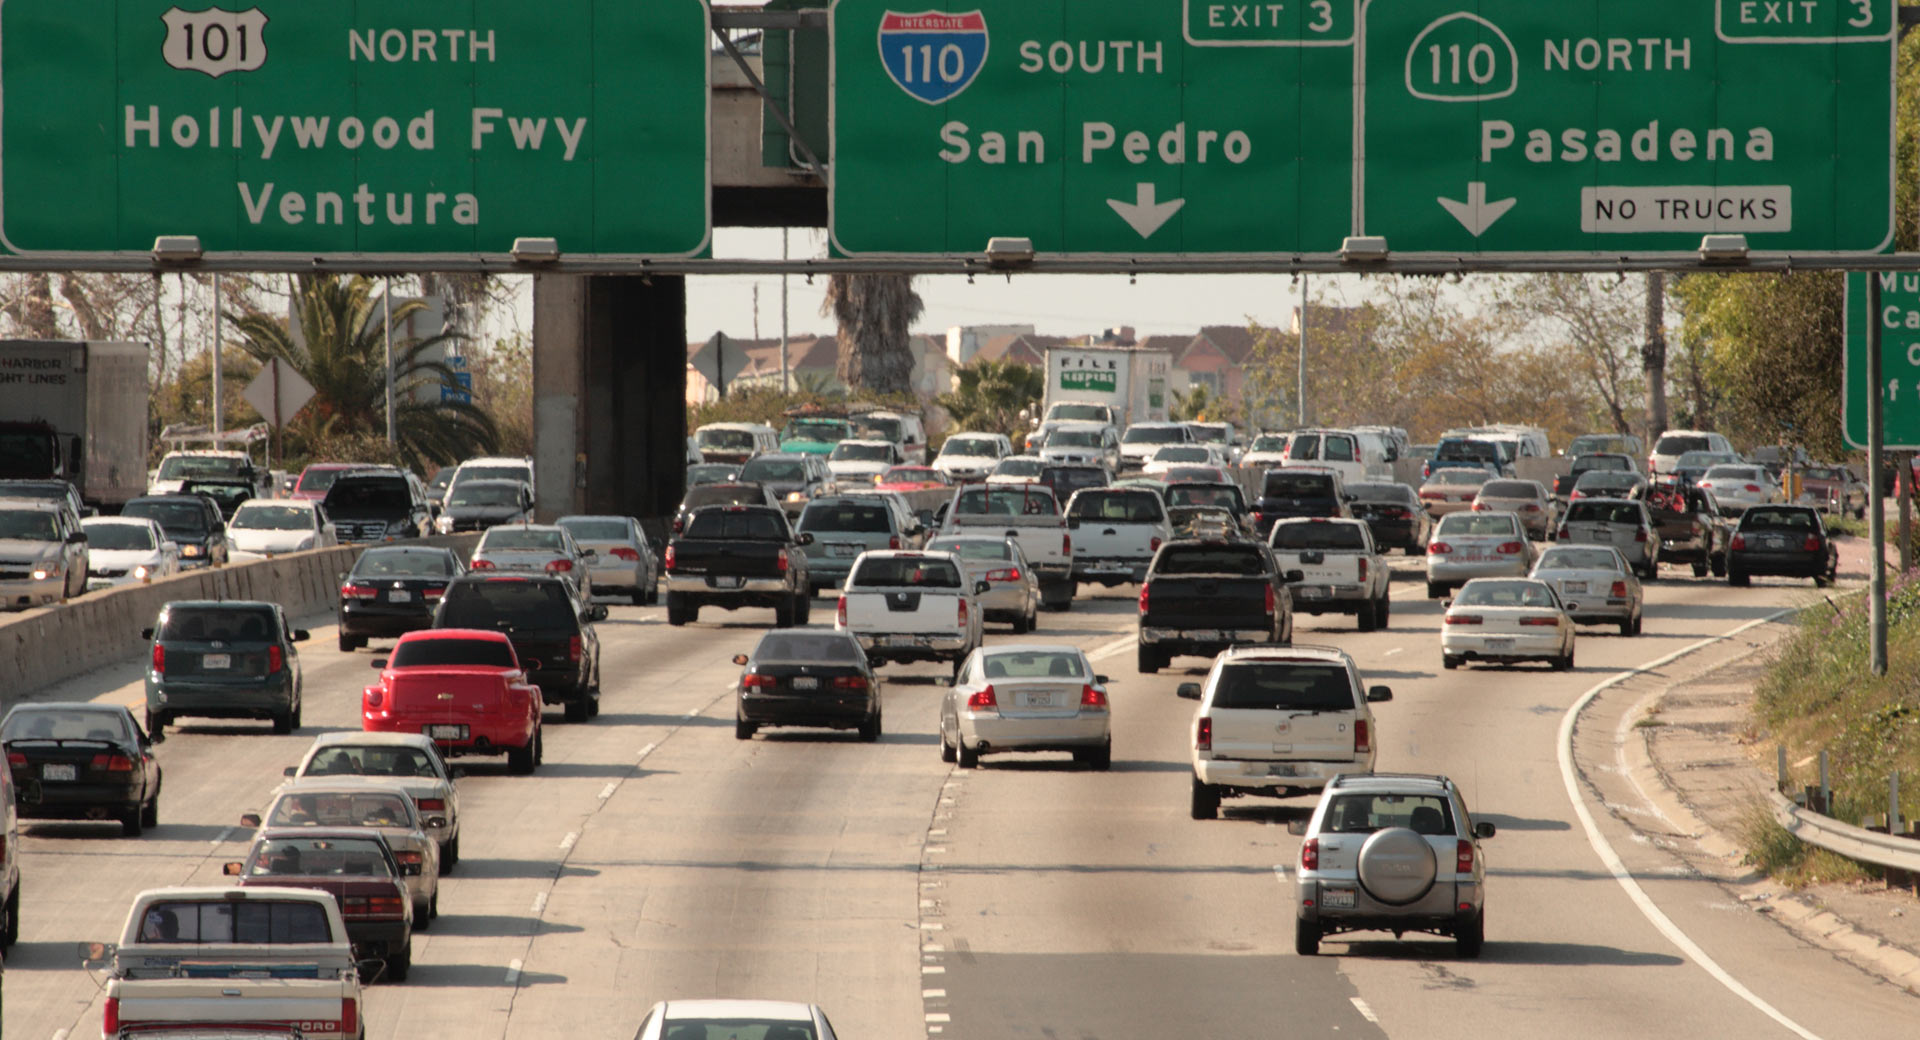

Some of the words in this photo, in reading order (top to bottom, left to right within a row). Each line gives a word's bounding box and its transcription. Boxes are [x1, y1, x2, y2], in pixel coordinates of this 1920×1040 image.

[900, 18, 964, 29] INTERSTATE
[1209, 5, 1283, 27] EXIT
[1309, 0, 1333, 32] 3
[1741, 1, 1817, 23] EXIT
[1848, 0, 1873, 27] 3
[183, 23, 248, 62] 101
[349, 29, 496, 62] NORTH
[1019, 40, 1164, 74] SOUTH
[1544, 38, 1691, 70] NORTH
[902, 43, 965, 84] 110
[1429, 43, 1496, 85] 110
[124, 104, 435, 159] Hollywood
[471, 107, 587, 160] Fwy
[938, 120, 1045, 163] San
[1082, 121, 1252, 164] Pedro
[1481, 119, 1774, 162] Pasadena
[237, 182, 480, 225] Ventura
[1595, 199, 1636, 220] NO
[1656, 198, 1777, 220] TRUCKS
[2, 358, 61, 368] HARBOR
[29, 374, 66, 385] LINES
[1061, 358, 1117, 369] FILE
